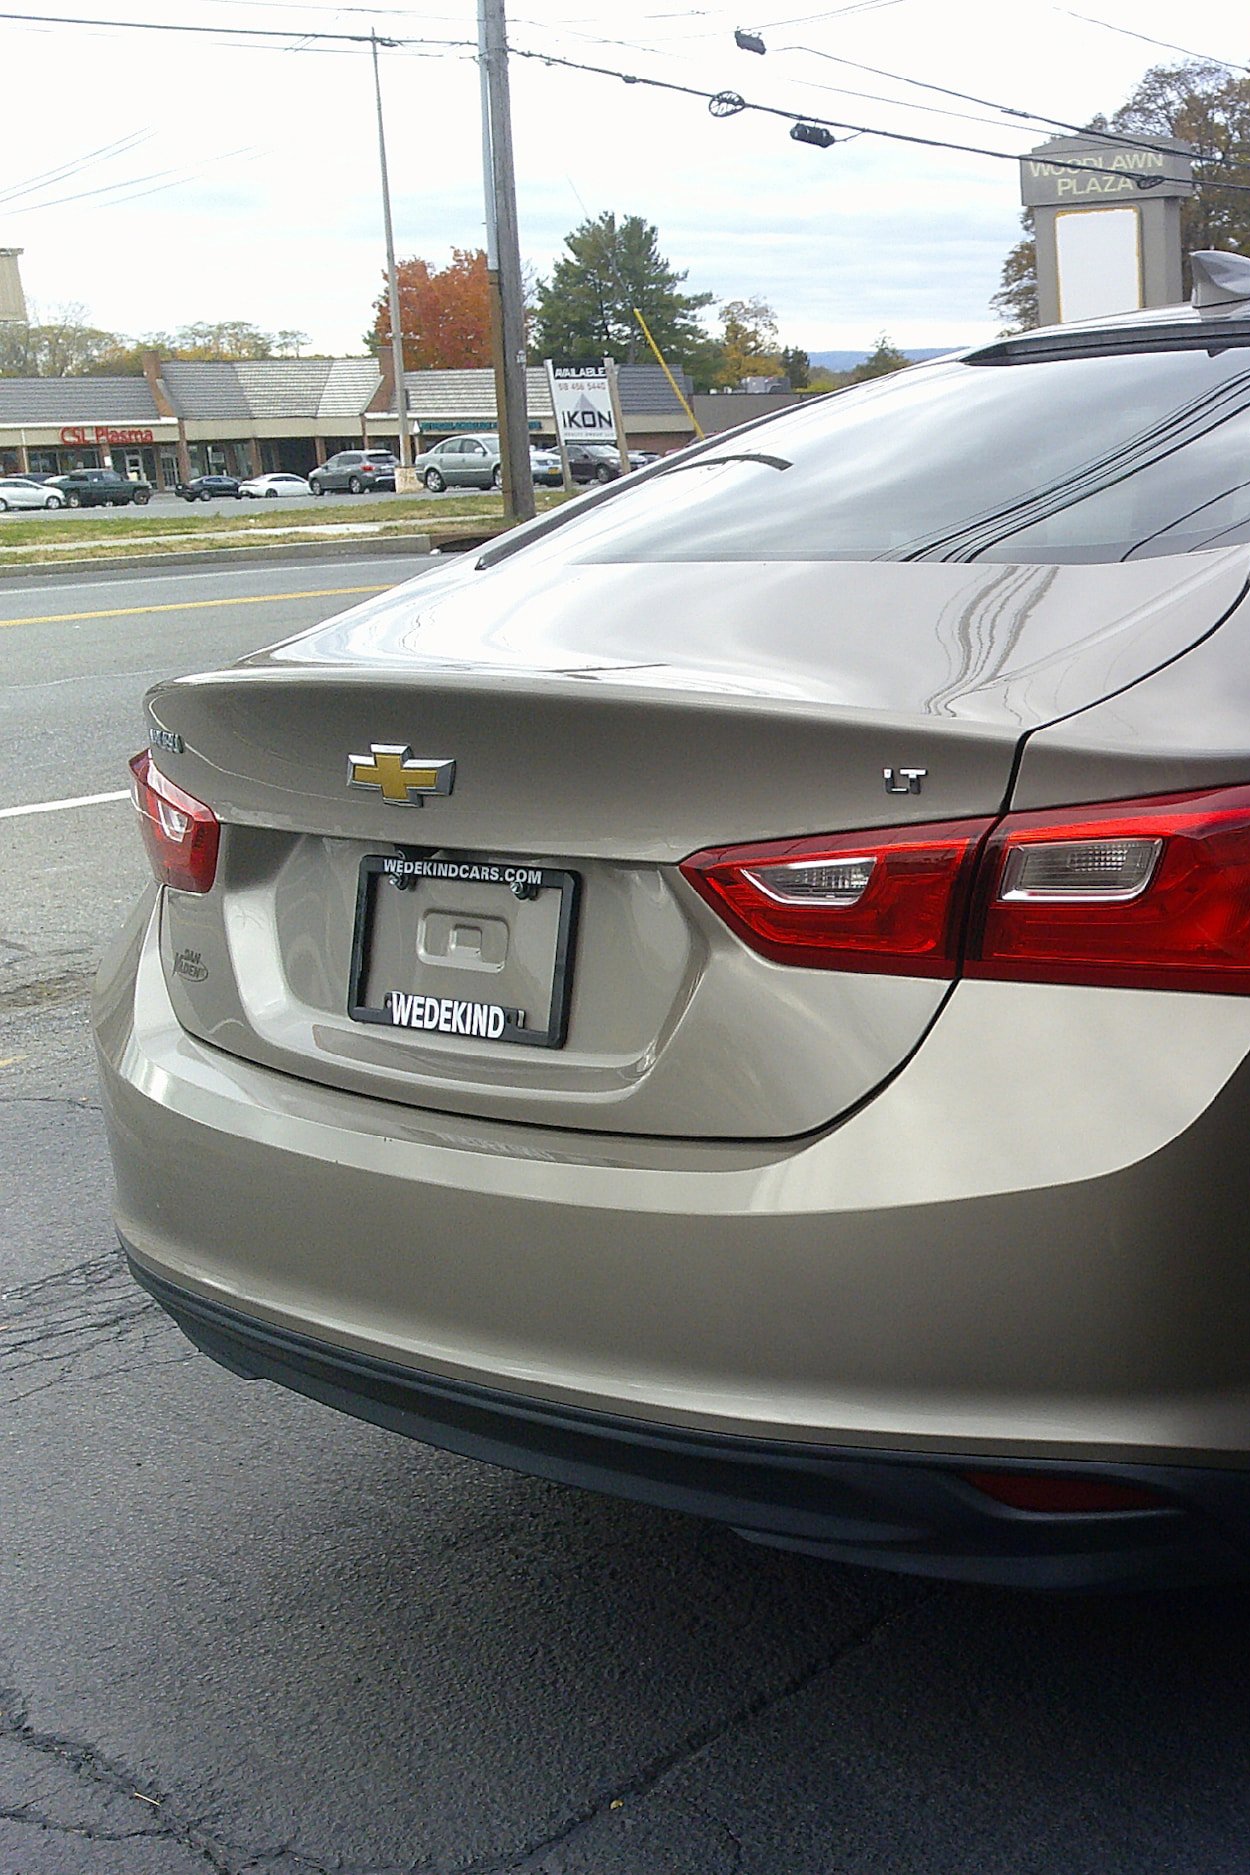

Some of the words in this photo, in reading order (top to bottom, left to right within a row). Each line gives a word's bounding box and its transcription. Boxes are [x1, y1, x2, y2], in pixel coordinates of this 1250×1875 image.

[1029, 153, 1164, 177] WOODLAWN
[1057, 176, 1134, 196] PLAZA
[555, 367, 607, 378] AVAILABLE
[562, 410, 613, 429] IKON
[61, 426, 91, 446] CSL
[95, 426, 154, 444] Plasma
[882, 768, 928, 795] LT
[383, 858, 543, 885] WEDEKINDCARS.COM
[390, 990, 506, 1040] WEDEKIND
